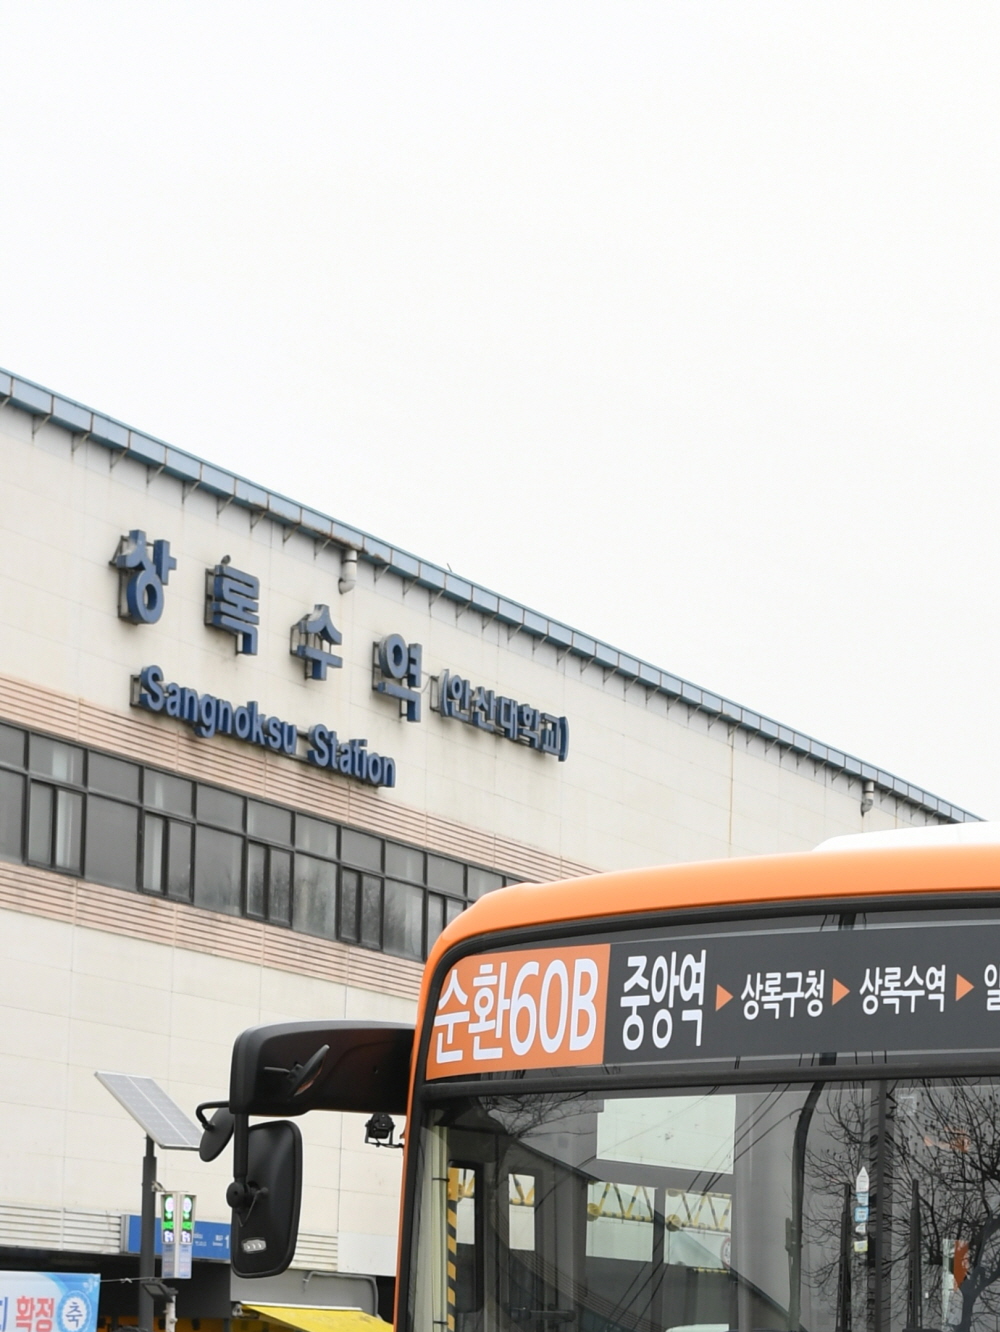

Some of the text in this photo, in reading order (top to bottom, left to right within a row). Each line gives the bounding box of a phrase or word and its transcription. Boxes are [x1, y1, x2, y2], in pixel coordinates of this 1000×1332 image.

[139, 664, 396, 788] Sangnoksu Station
[440, 668, 570, 763] (안산대학교)
[434, 956, 599, 1064] 순환60B
[620, 949, 707, 1051] 중앙역
[740, 969, 825, 1021] 상록구청
[859, 964, 947, 1016] 상록수역
[65, 1301, 83, 1328] 축
